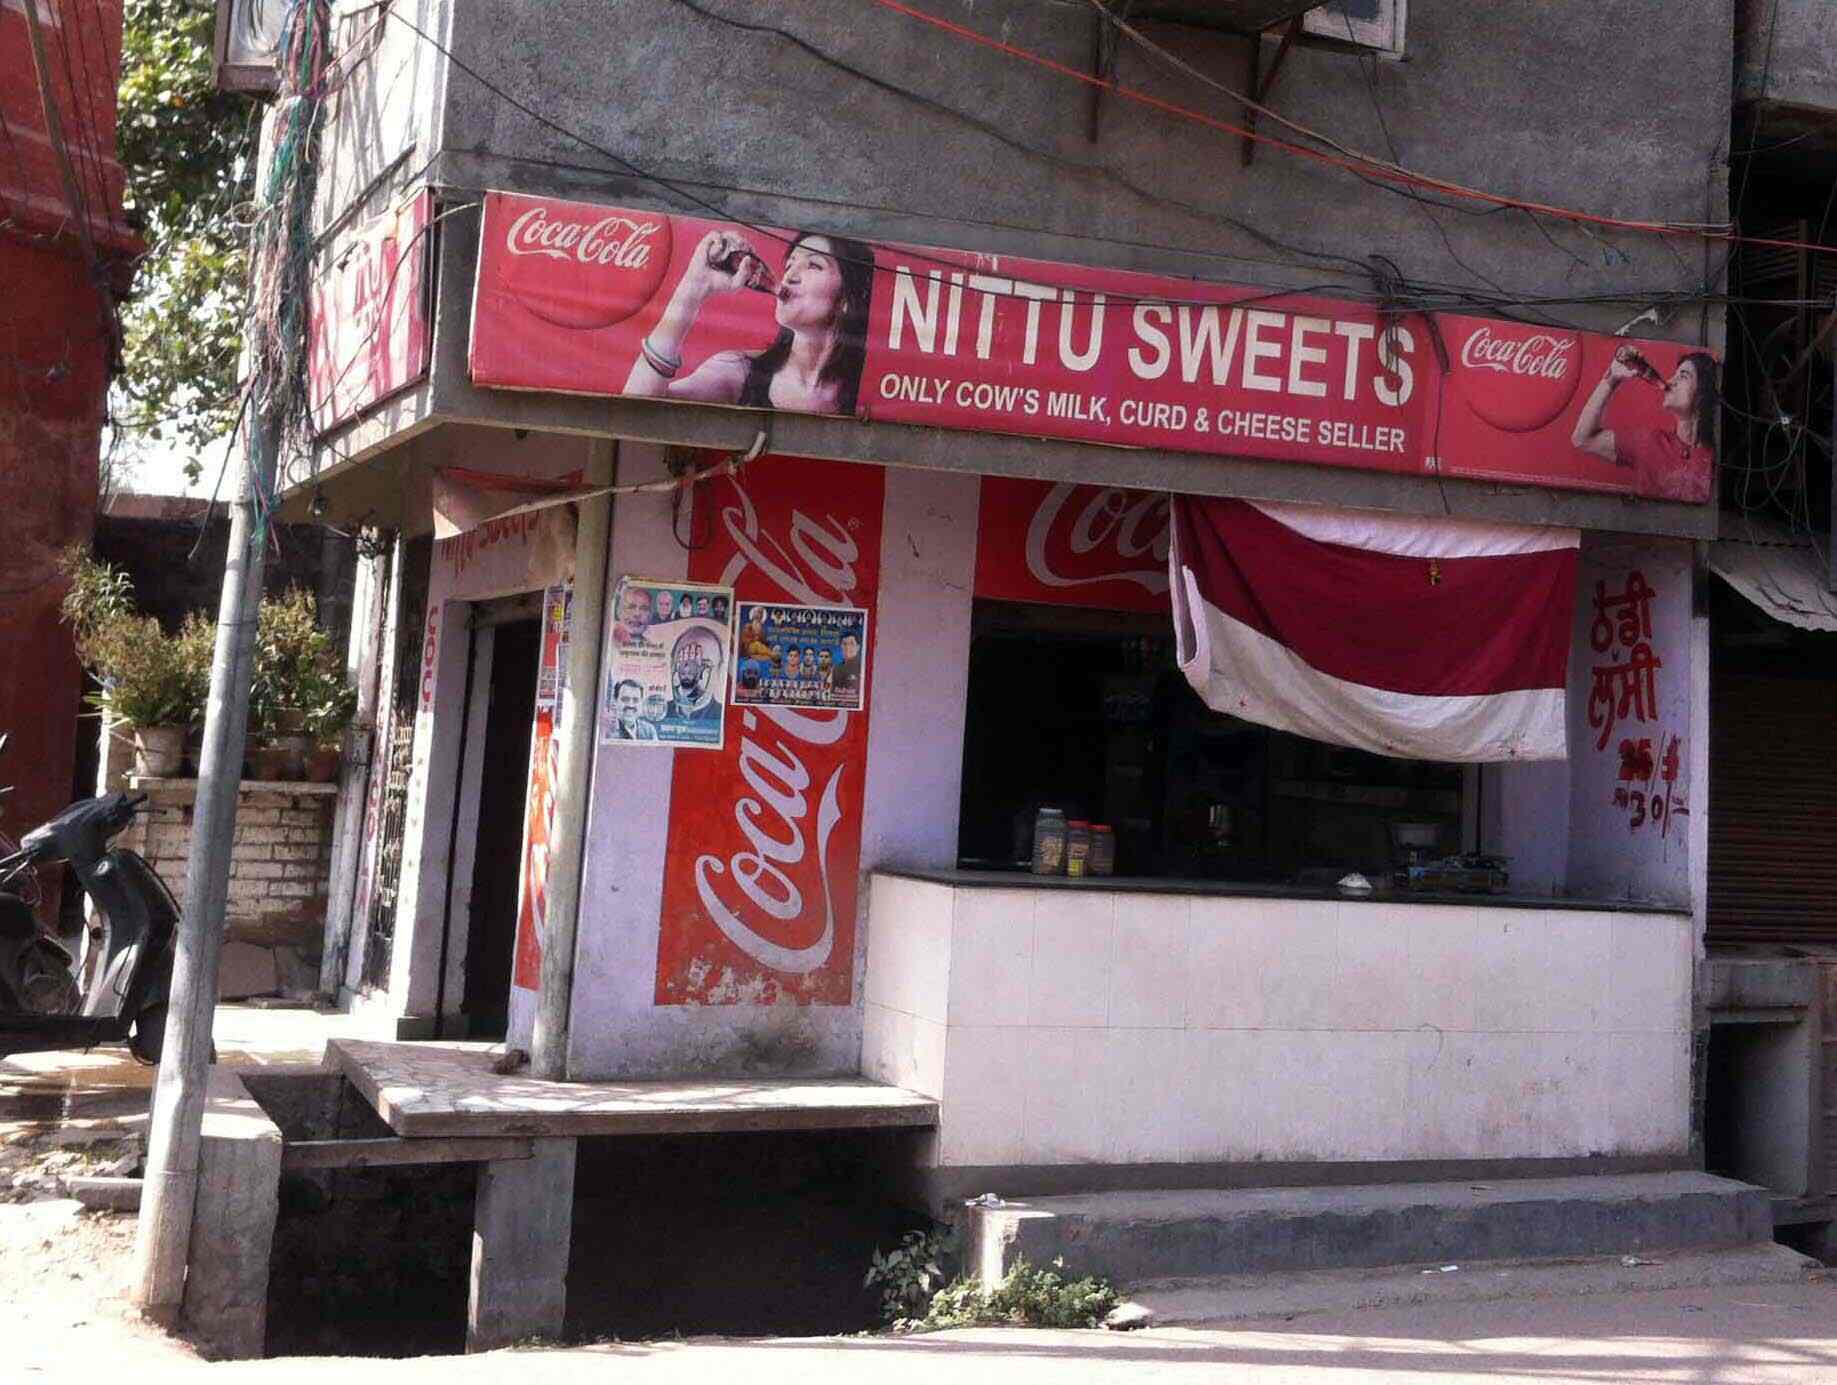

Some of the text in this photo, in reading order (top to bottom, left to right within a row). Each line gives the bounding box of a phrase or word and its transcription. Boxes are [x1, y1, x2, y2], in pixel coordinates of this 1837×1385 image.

[889, 266, 1415, 407] NITTU SWEETS
[880, 373, 1406, 453] ONLY COW'S MILK, CURD & CHEESE SELLER
